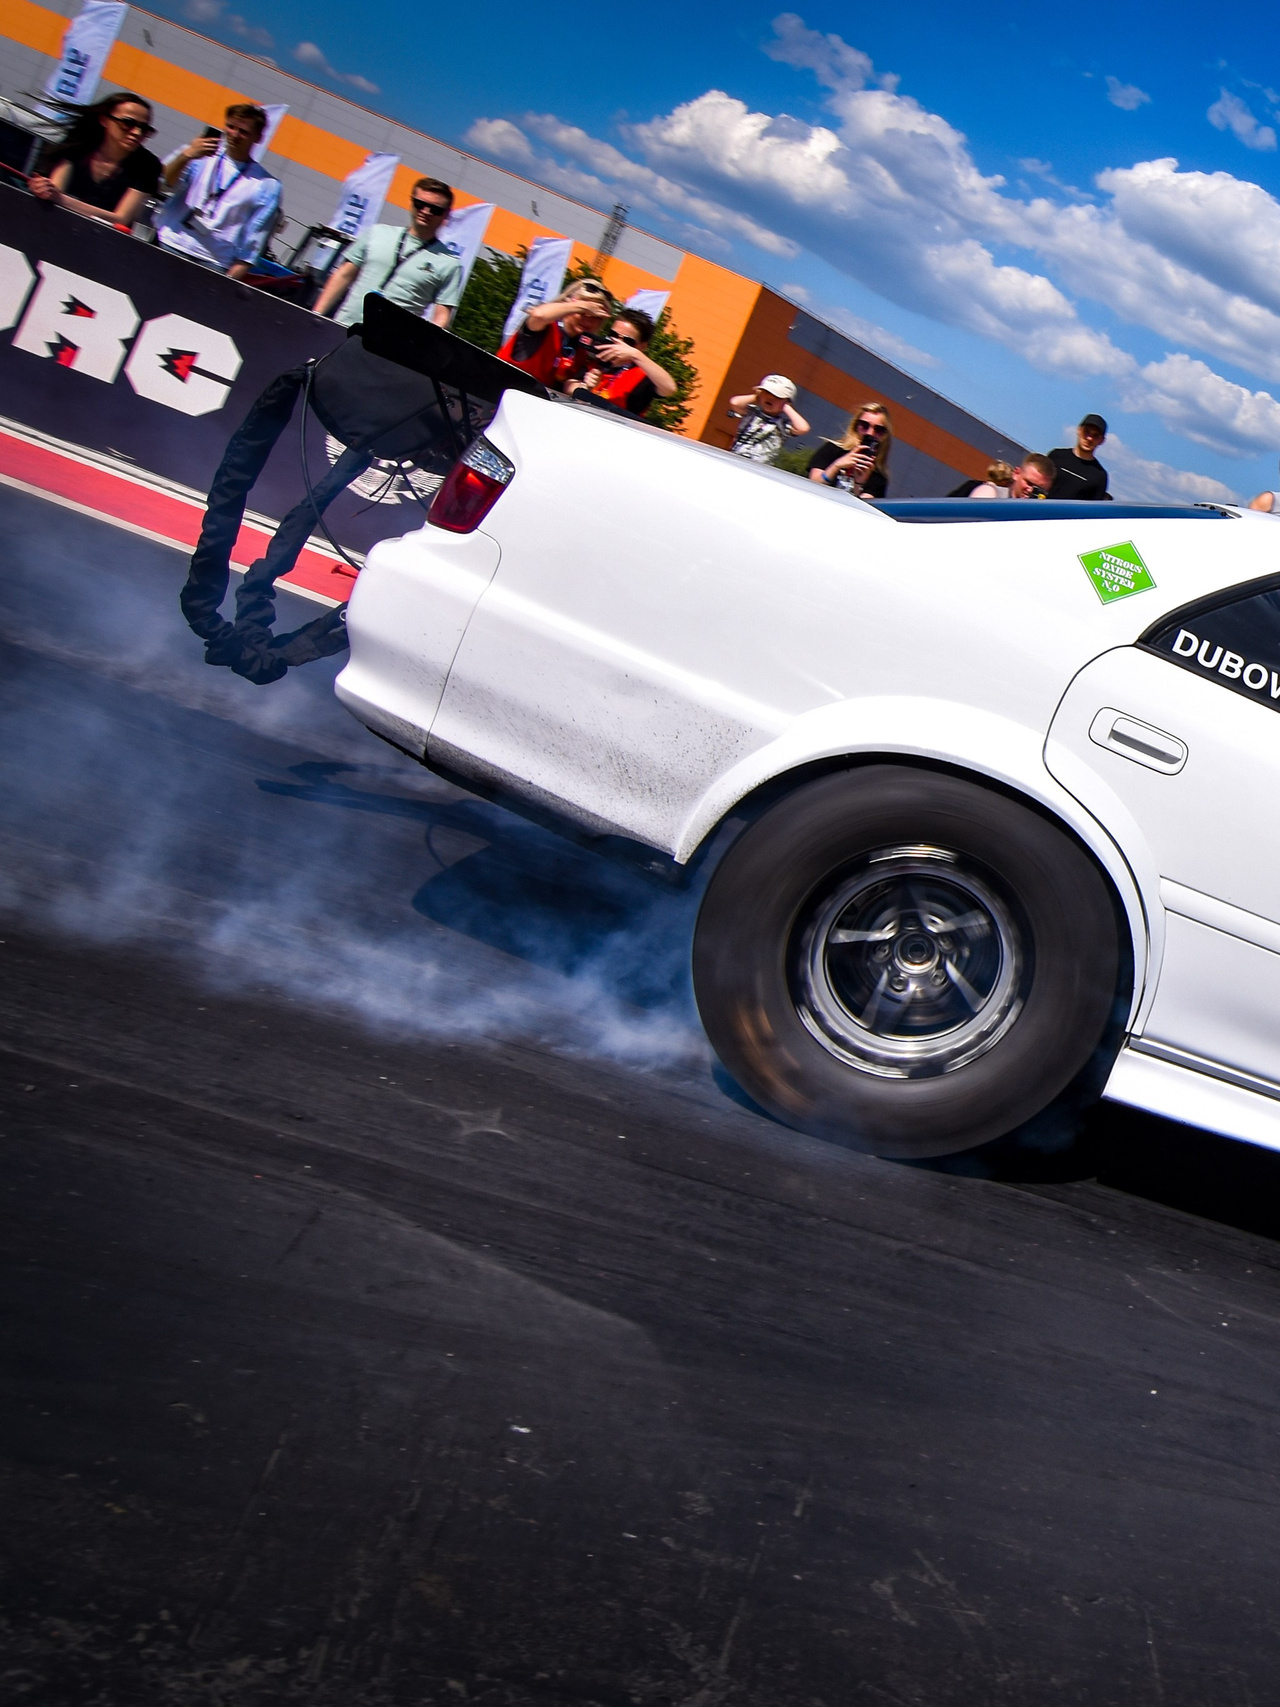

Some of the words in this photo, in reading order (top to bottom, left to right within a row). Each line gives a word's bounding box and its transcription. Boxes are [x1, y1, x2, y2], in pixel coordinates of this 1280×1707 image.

[1099, 551, 1143, 574] NITROUS
[1102, 562, 1134, 579] OXIDE
[1093, 567, 1136, 590] SYSTEM
